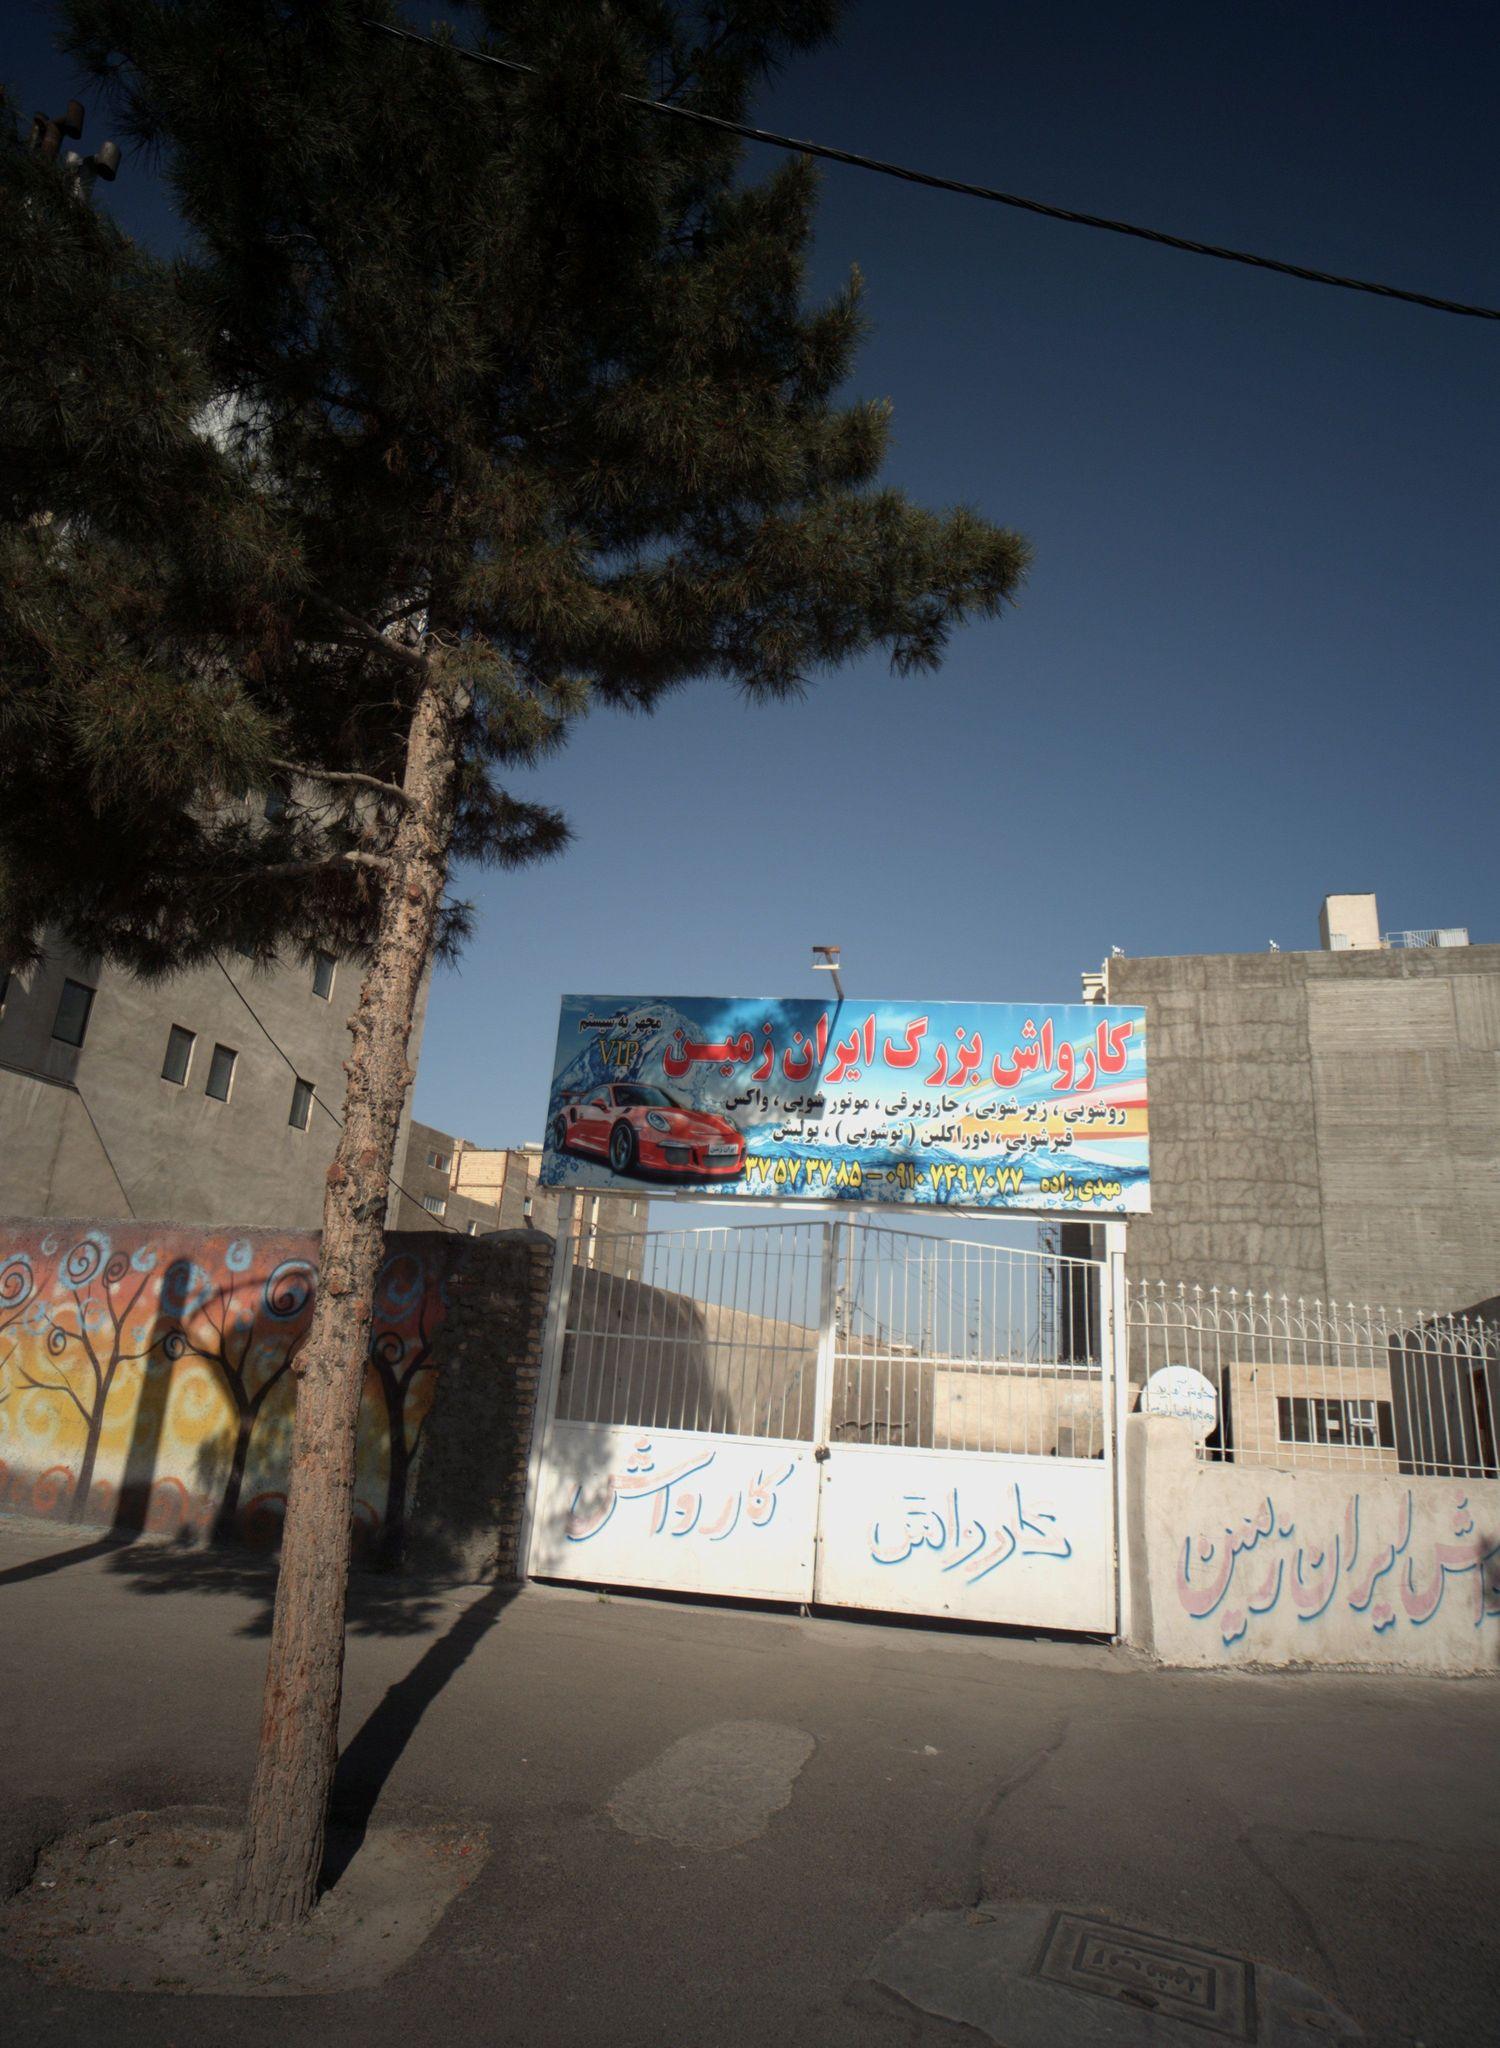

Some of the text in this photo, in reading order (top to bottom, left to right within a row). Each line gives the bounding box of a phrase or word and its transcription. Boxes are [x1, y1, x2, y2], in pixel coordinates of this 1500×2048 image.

[579, 1012, 615, 1033] سیستم
[618, 1016, 629, 1034] به
[599, 1040, 640, 1066] VIP
[662, 1012, 1134, 1091] کارواش بزرگ ایران زمین
[725, 1089, 769, 1112] واکس
[773, 1119, 819, 1143] پولیش
[1040, 1170, 1075, 1201] زاده
[1077, 1177, 1122, 1202] مهدی
[565, 1434, 795, 1542] کارواش
[869, 1481, 1072, 1586] کارواش
[1290, 1489, 1413, 1633] ایران
